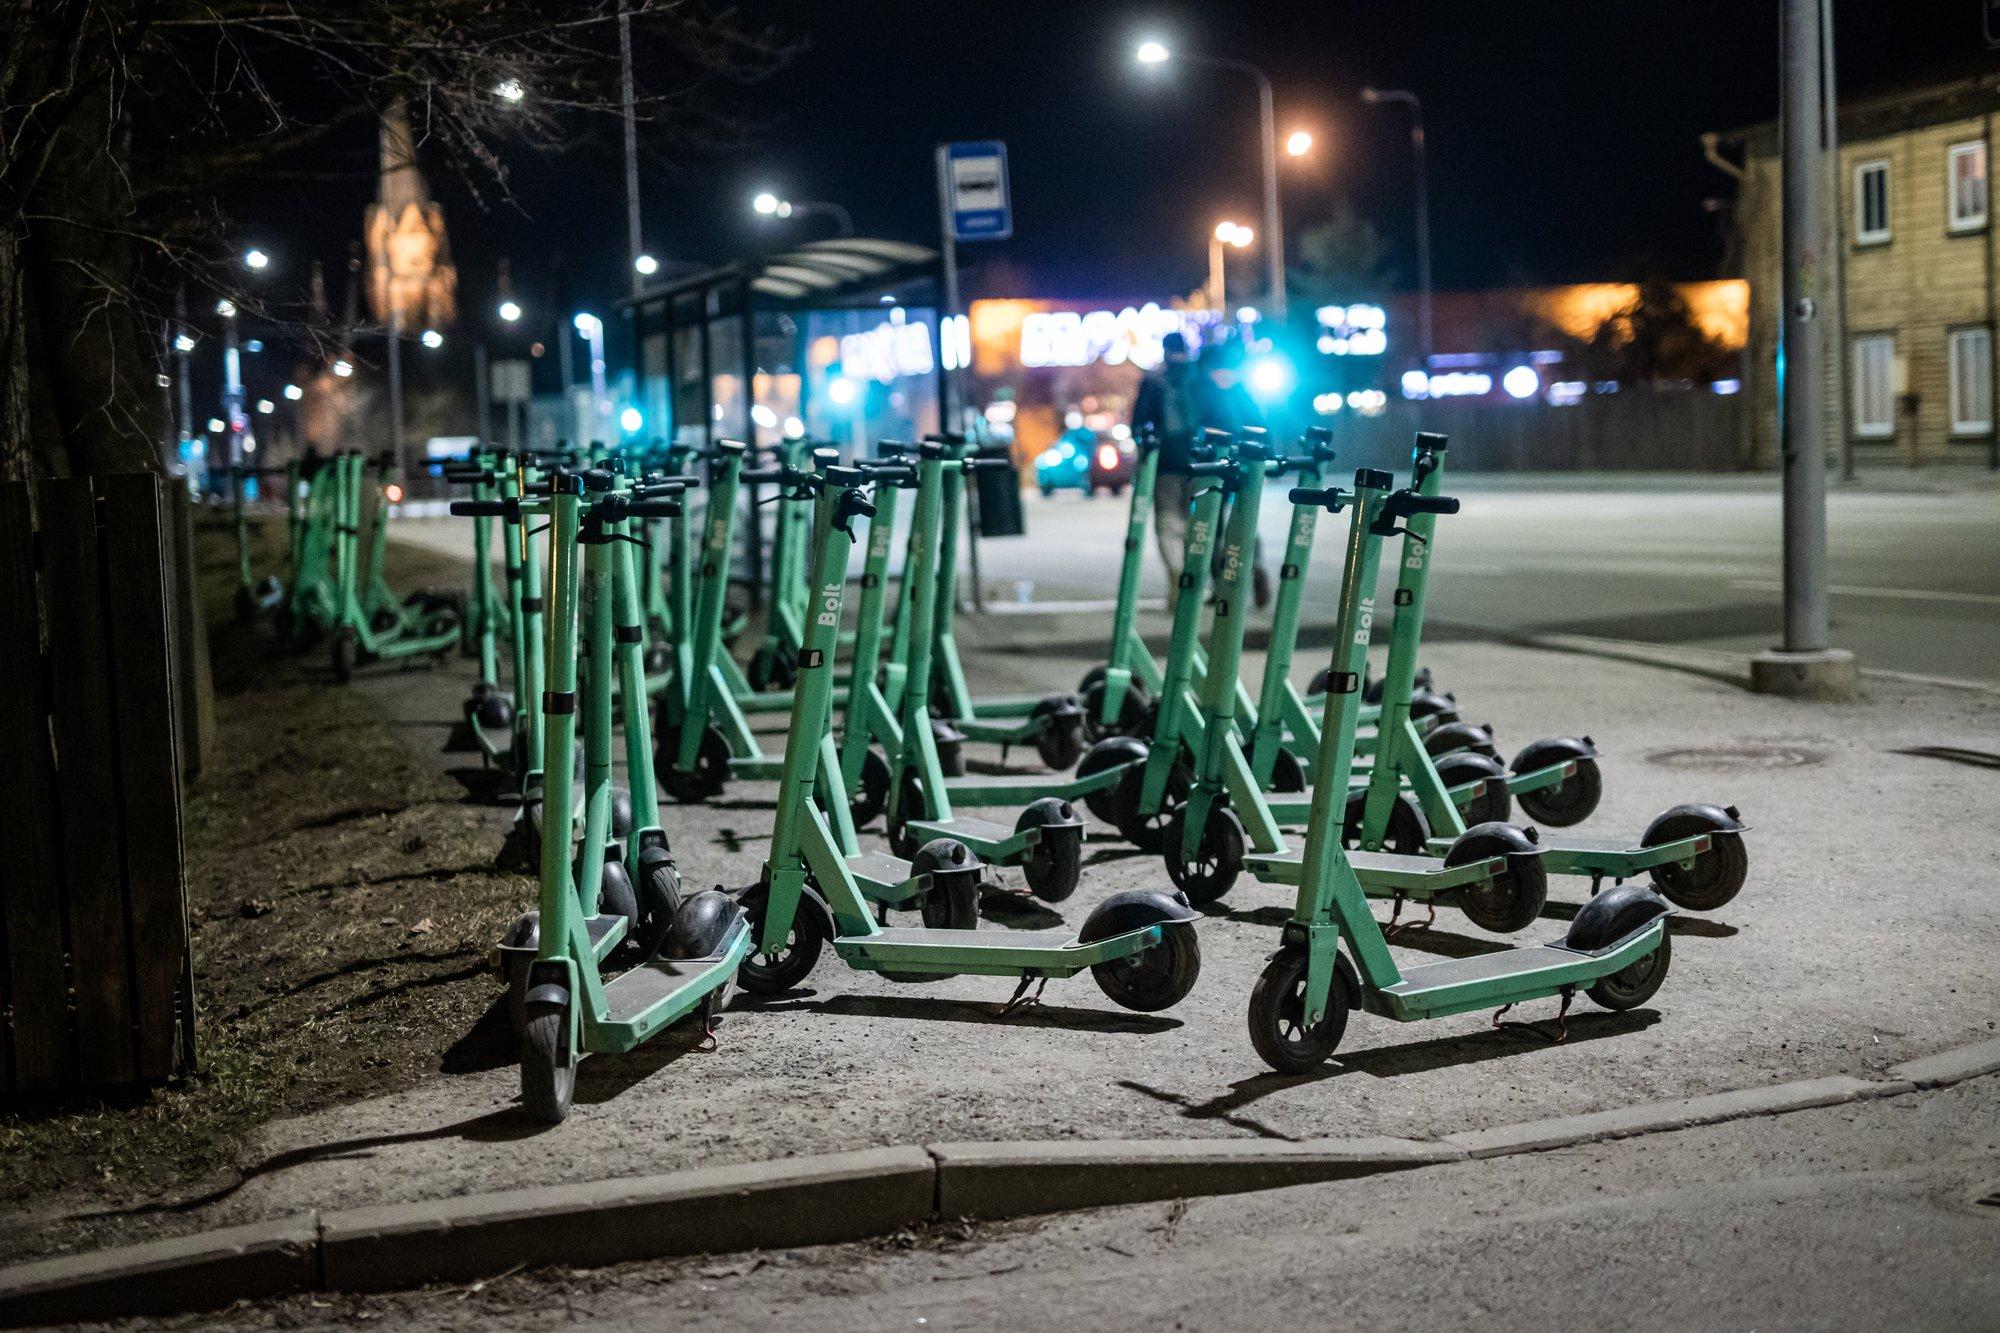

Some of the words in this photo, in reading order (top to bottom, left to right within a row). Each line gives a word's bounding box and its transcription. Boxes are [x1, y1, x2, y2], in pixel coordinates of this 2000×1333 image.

[1190, 521, 1210, 555] Bolt
[1295, 513, 1316, 546] Bolt
[1223, 544, 1241, 582] Bolt
[817, 582, 841, 626] Bolt
[1354, 597, 1375, 645] Bolt
